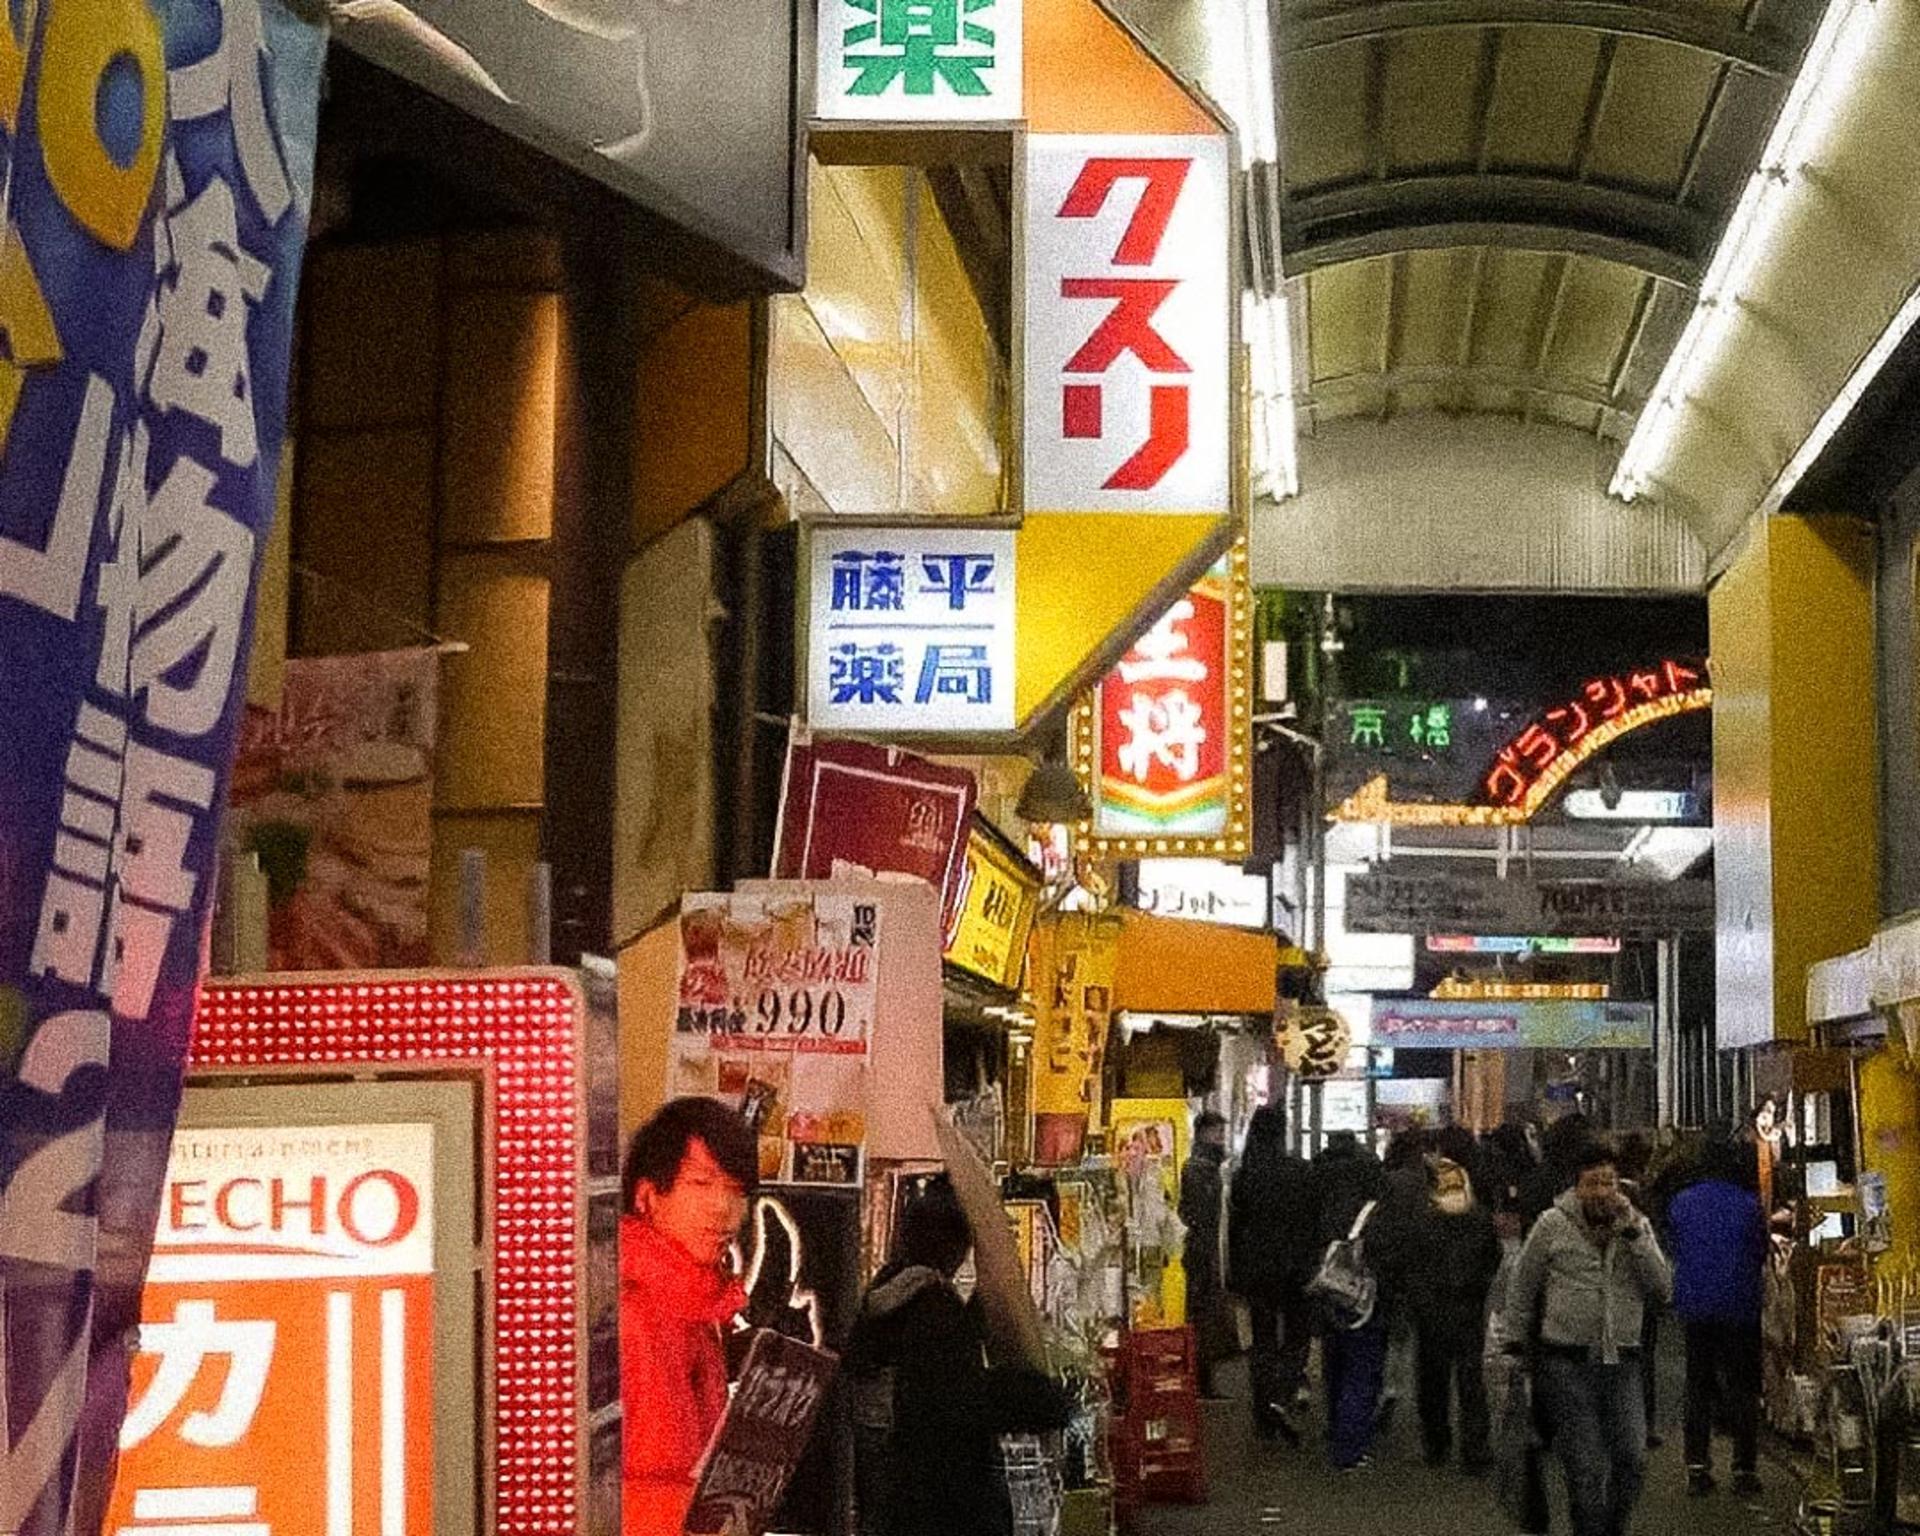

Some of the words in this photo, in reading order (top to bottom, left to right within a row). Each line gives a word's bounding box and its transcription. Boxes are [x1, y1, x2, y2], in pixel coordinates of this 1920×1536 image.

[1055, 158, 1194, 490] クスリ
[830, 551, 995, 611] 藤平
[828, 642, 994, 705] 薬局
[755, 987, 847, 1036] 990
[169, 1168, 420, 1247] ECHO
